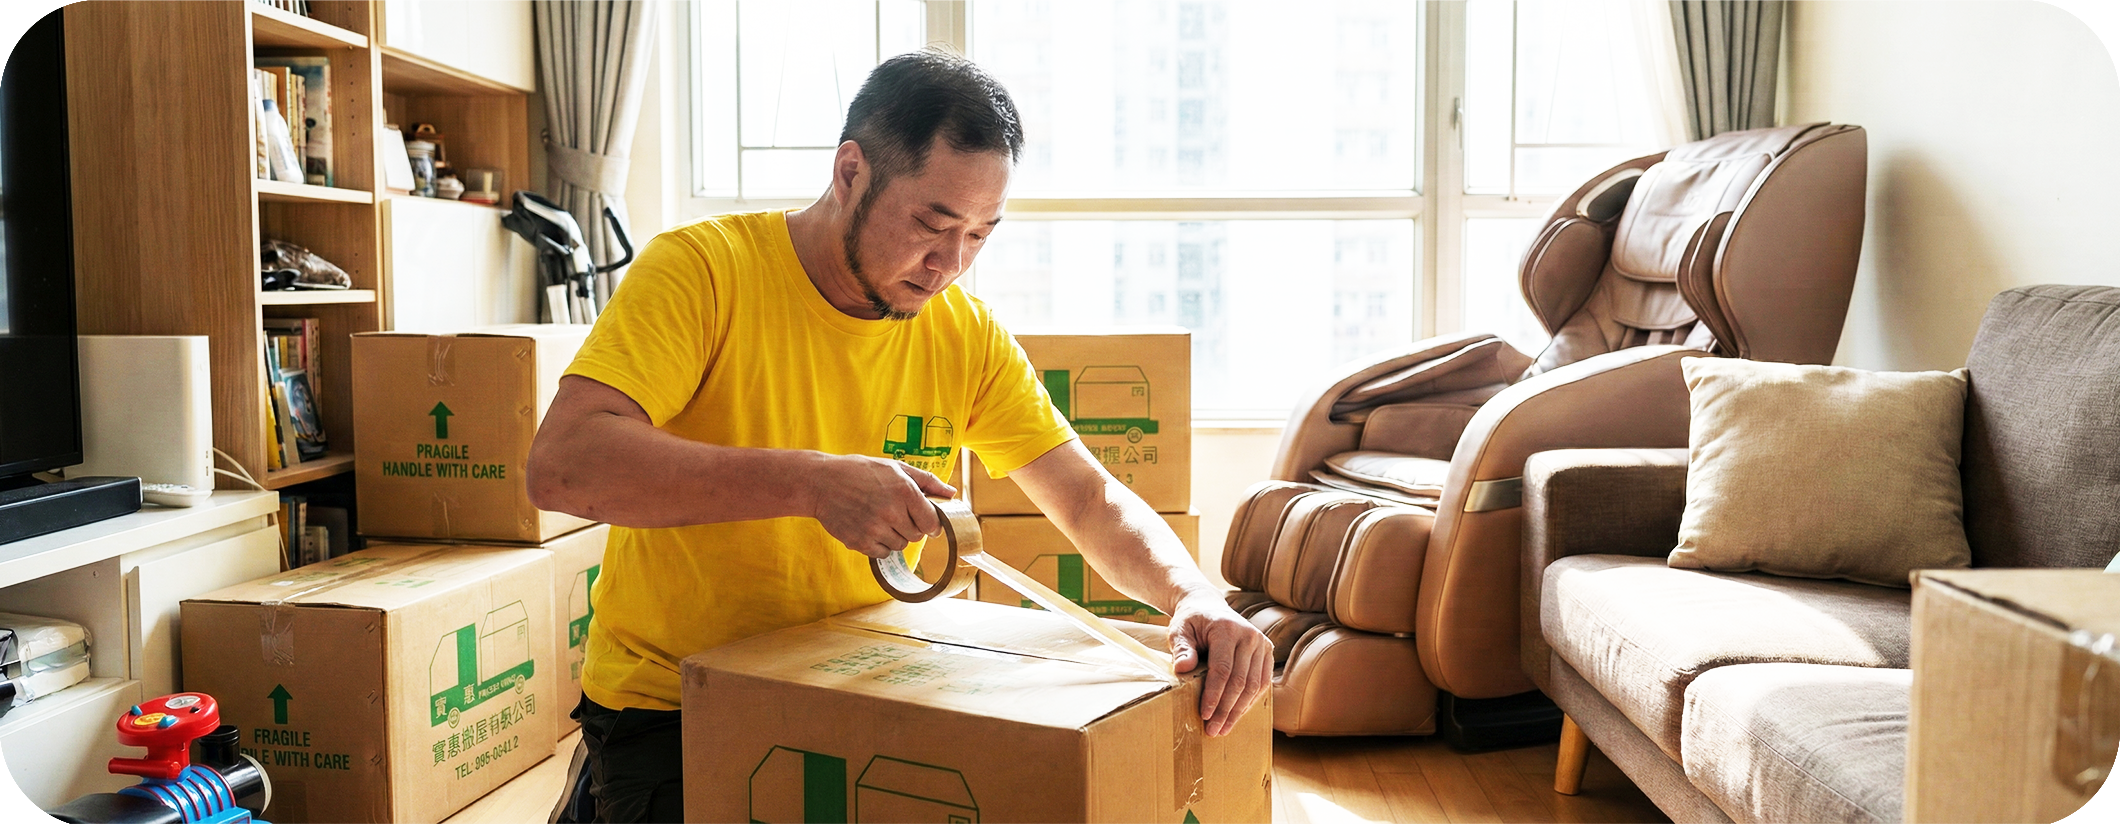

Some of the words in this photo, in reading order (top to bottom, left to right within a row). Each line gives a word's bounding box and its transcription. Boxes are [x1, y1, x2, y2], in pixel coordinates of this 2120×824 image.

[417, 444, 469, 459] PRAGILE
[383, 462, 433, 477] HANDLE
[436, 463, 468, 478] WITH
[472, 464, 506, 479] CARE
[254, 729, 311, 747] FRAGILE
[273, 750, 310, 767] WITH
[314, 752, 350, 770] CARE
